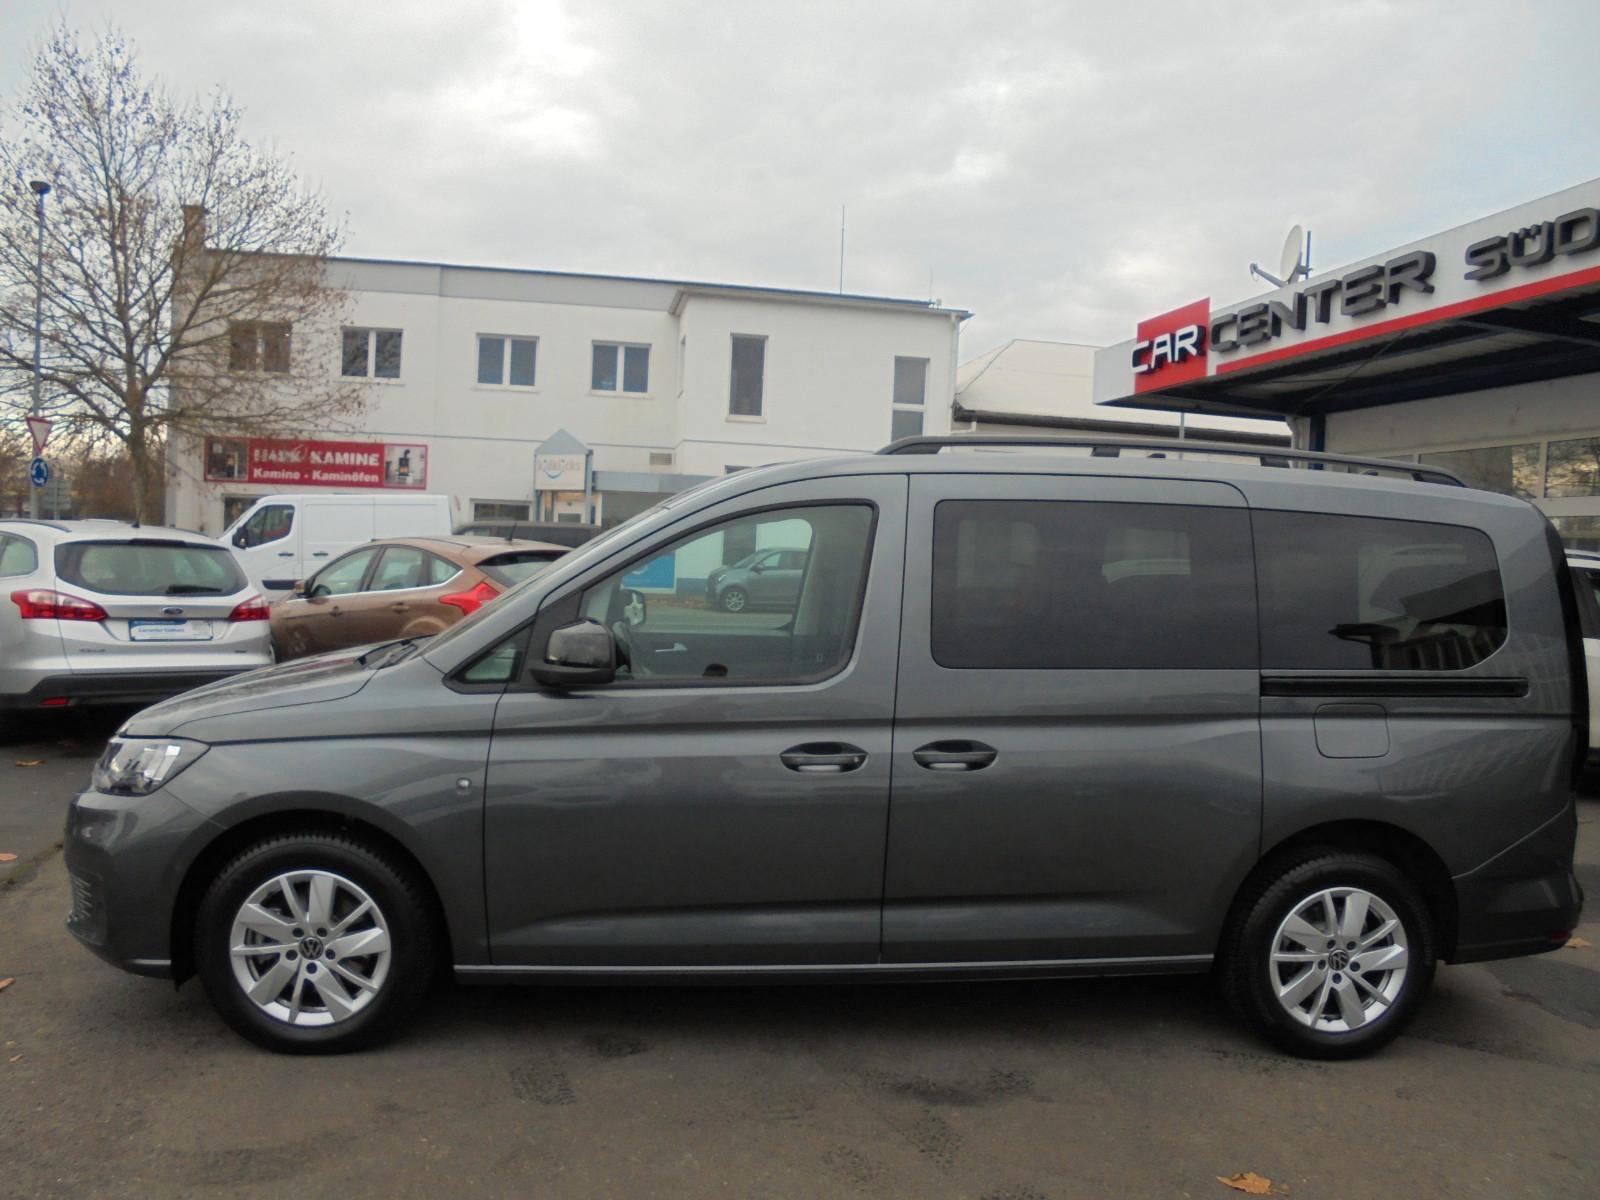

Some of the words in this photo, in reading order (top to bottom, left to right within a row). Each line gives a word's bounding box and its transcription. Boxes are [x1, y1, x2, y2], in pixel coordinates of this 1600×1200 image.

[1131, 324, 1204, 374] CAR
[1208, 250, 1436, 352] CENTER
[1464, 207, 1600, 281] SÜD
[309, 450, 380, 467] KAMINE
[253, 467, 301, 480] Kamine
[311, 469, 379, 483] Kaminöfen
